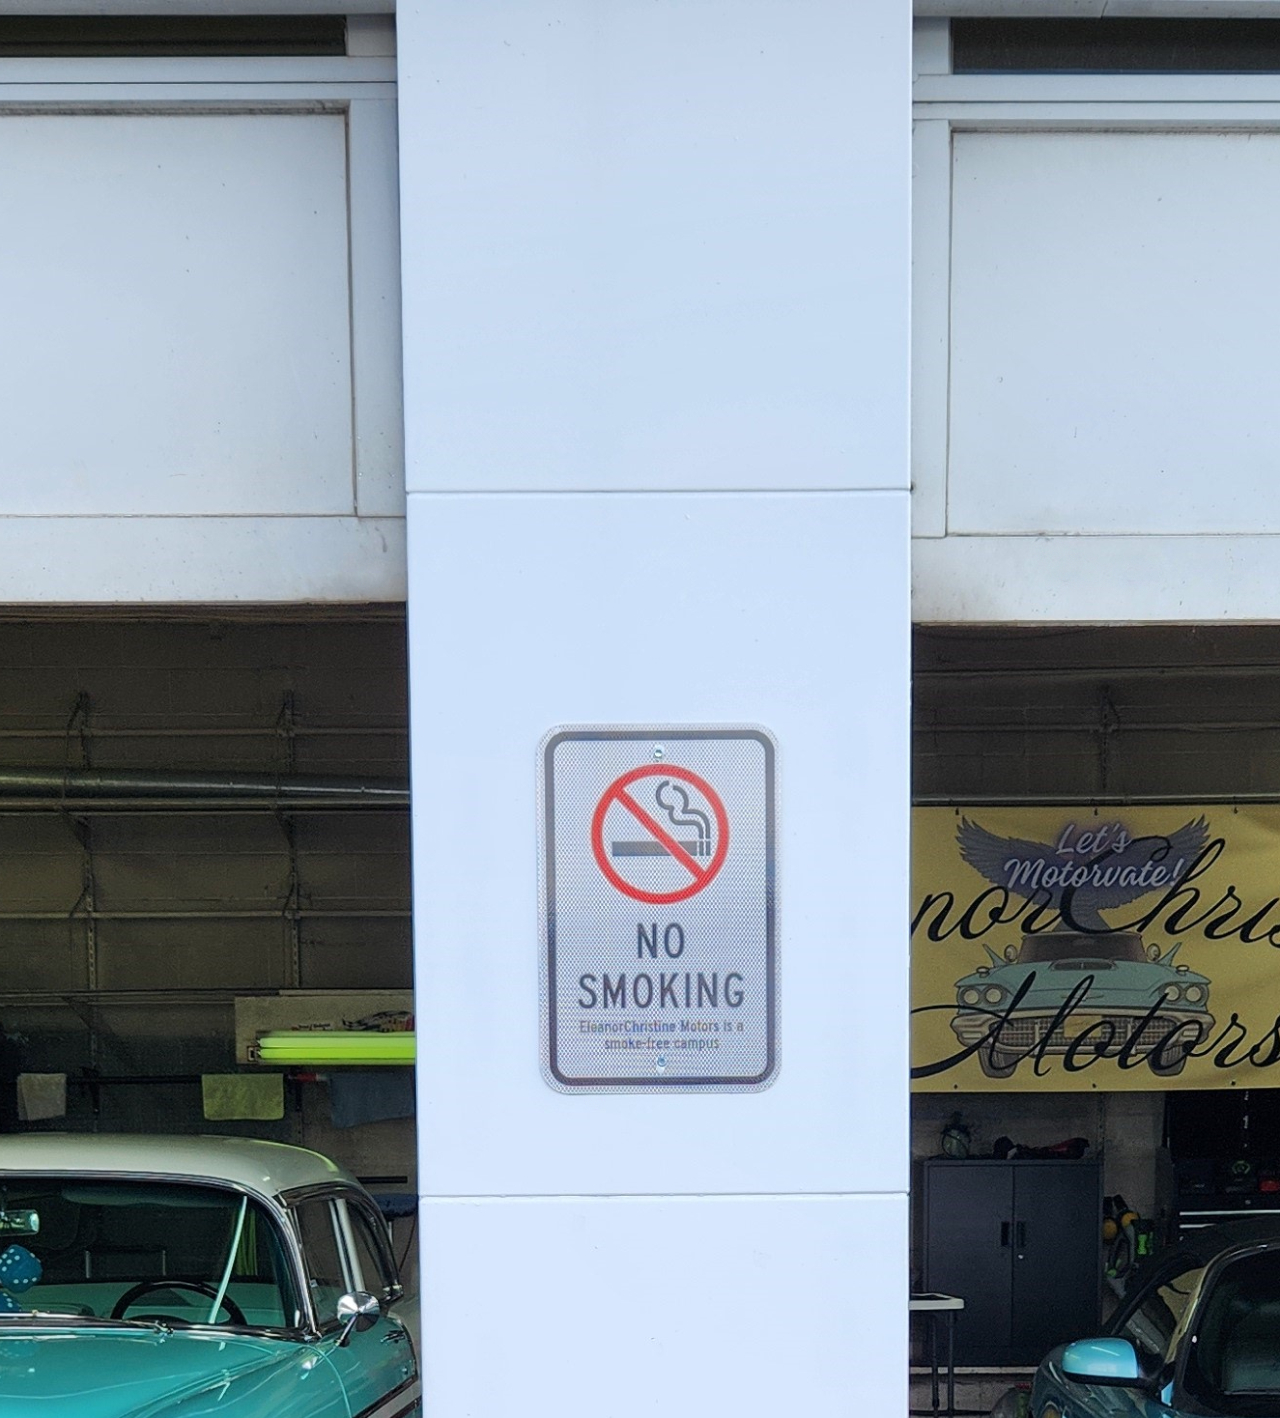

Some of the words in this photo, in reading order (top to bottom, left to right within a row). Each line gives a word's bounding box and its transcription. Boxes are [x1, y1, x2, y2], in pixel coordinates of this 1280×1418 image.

[1055, 822, 1132, 855] Let's
[1003, 857, 1185, 889] Motorvate!
[637, 922, 685, 959] NO
[578, 972, 745, 1009] SMOKING
[579, 1020, 676, 1033] EleanorChristine
[680, 1020, 720, 1032] Motors
[723, 1020, 733, 1032] is
[736, 1022, 744, 1032] a
[604, 1036, 670, 1049] smoke-free
[674, 1038, 720, 1050] campus
